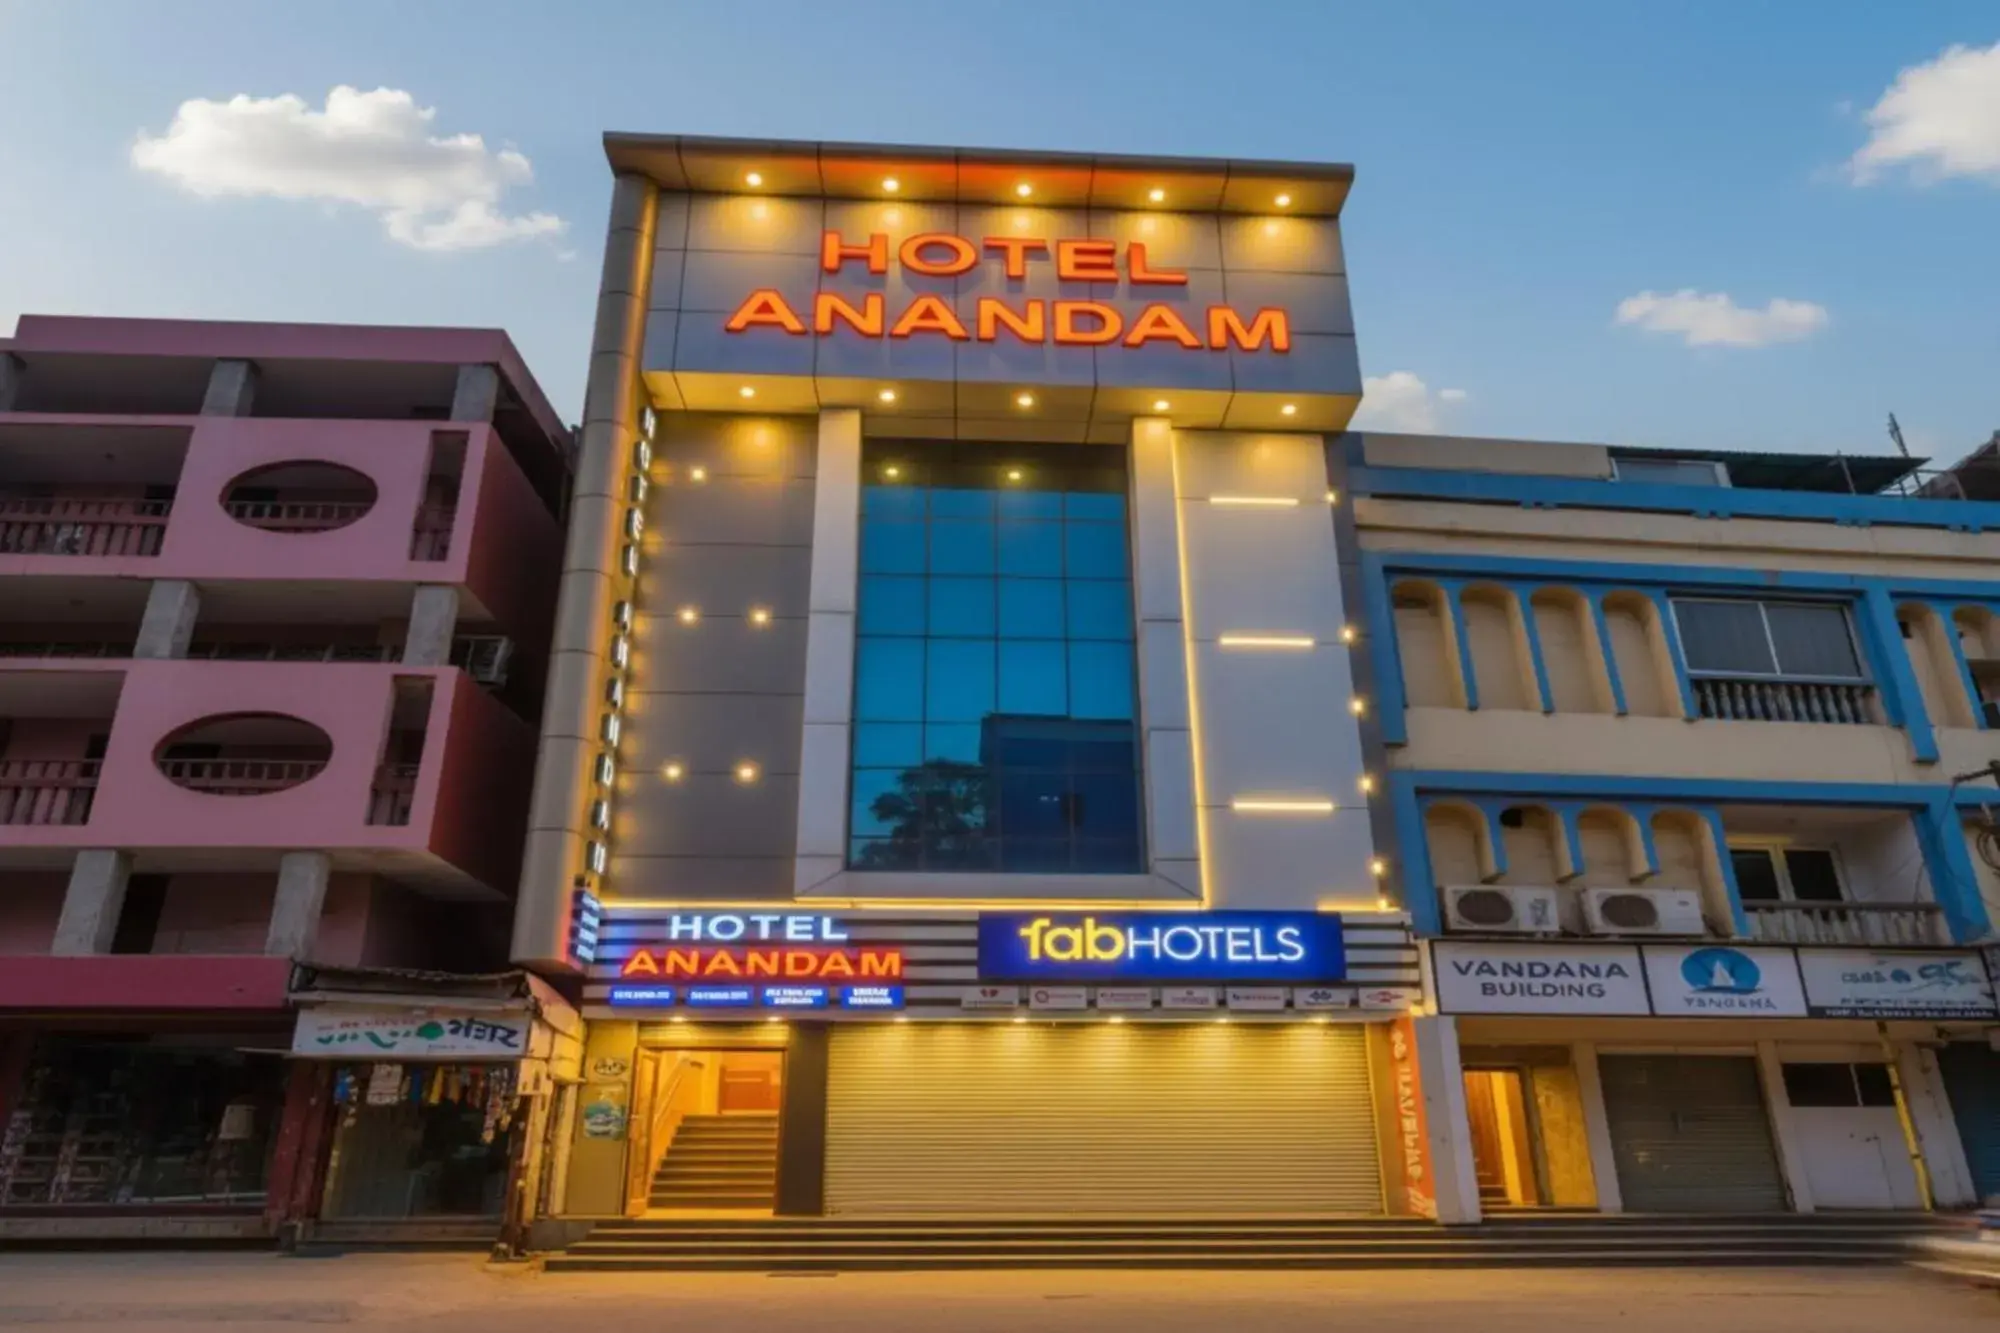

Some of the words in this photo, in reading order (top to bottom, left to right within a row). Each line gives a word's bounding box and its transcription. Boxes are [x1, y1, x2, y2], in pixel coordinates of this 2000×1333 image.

[820, 230, 1189, 285] HOTEL
[724, 288, 1291, 352] ANANDAM
[669, 914, 849, 941] HOTEL
[1019, 917, 1305, 961] fabHOTELS
[622, 949, 902, 977] ANANDAM
[1452, 959, 1630, 979] VANDANA
[1480, 982, 1607, 999] BUILDING
